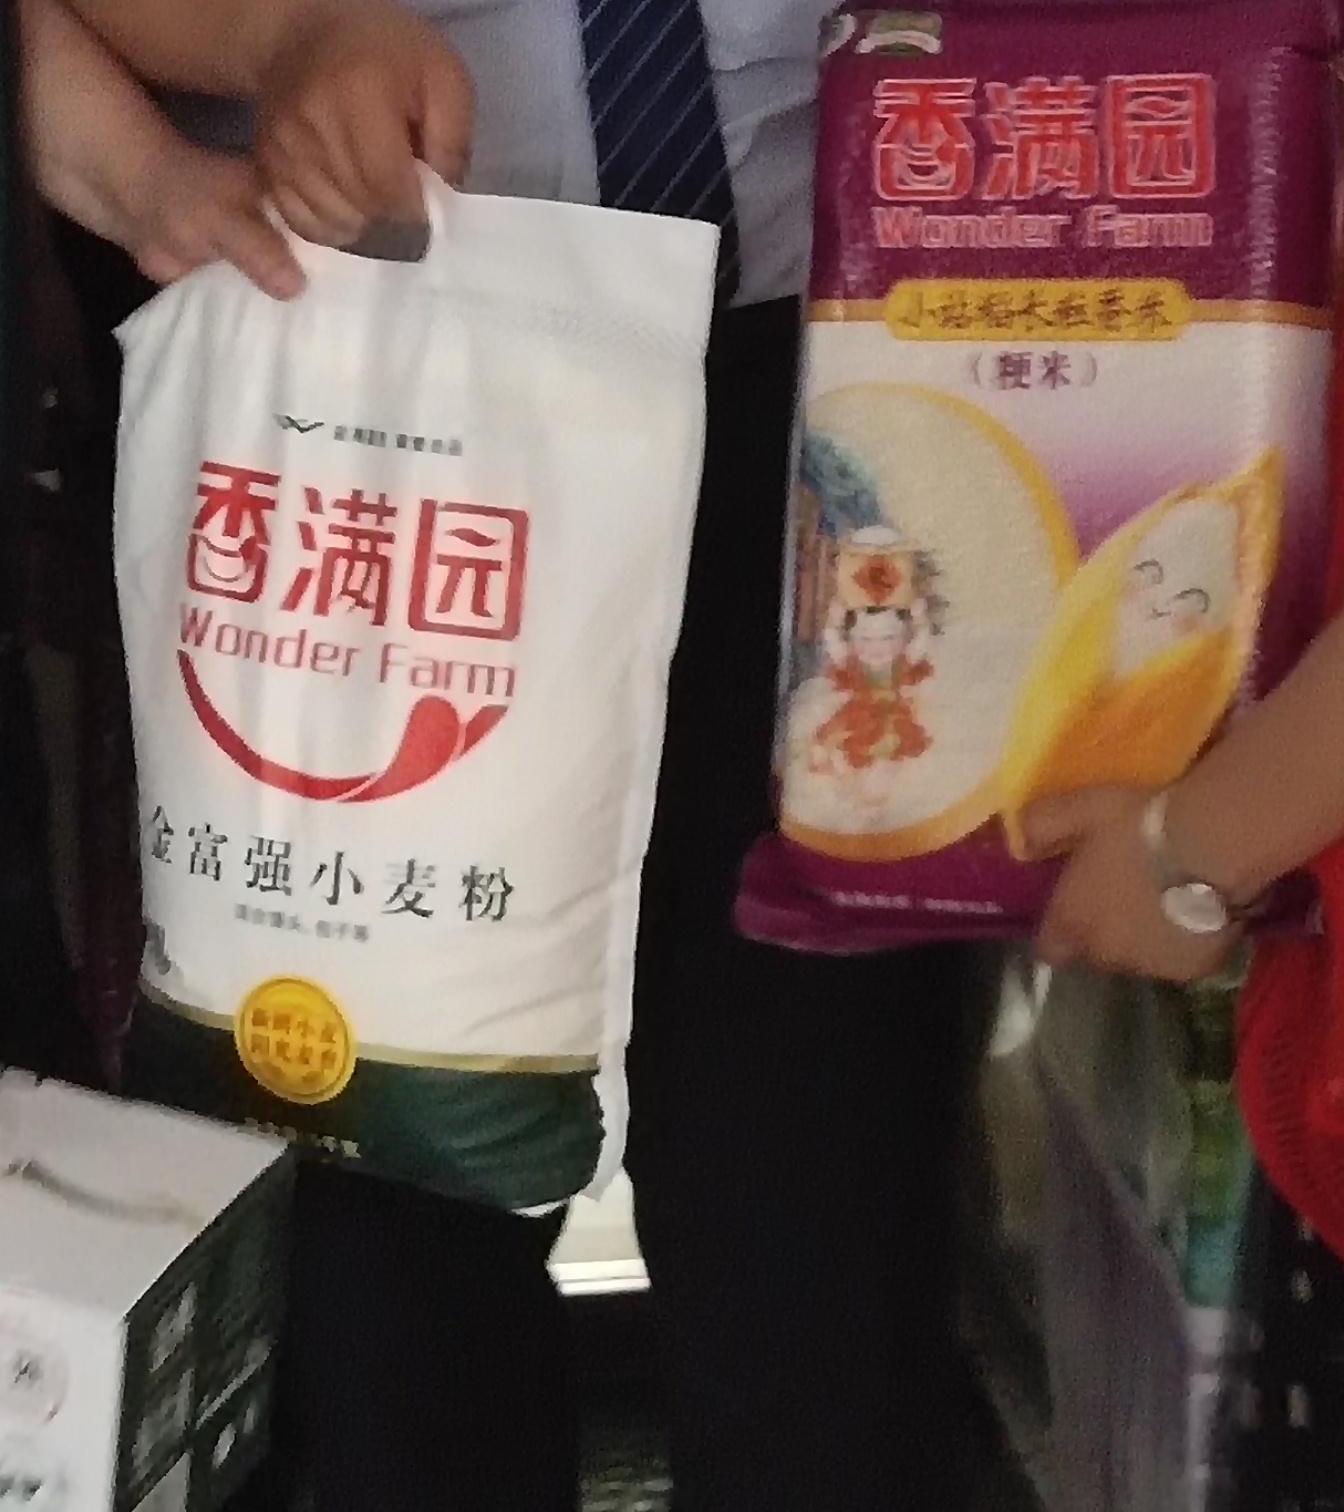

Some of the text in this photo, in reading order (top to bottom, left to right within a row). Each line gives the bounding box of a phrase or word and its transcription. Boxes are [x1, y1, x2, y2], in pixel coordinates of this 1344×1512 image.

[872, 73, 1217, 201] 香满园
[871, 204, 1214, 249] Wonder Farm
[188, 460, 530, 642] 香满园
[179, 603, 516, 698] Wonder Farm
